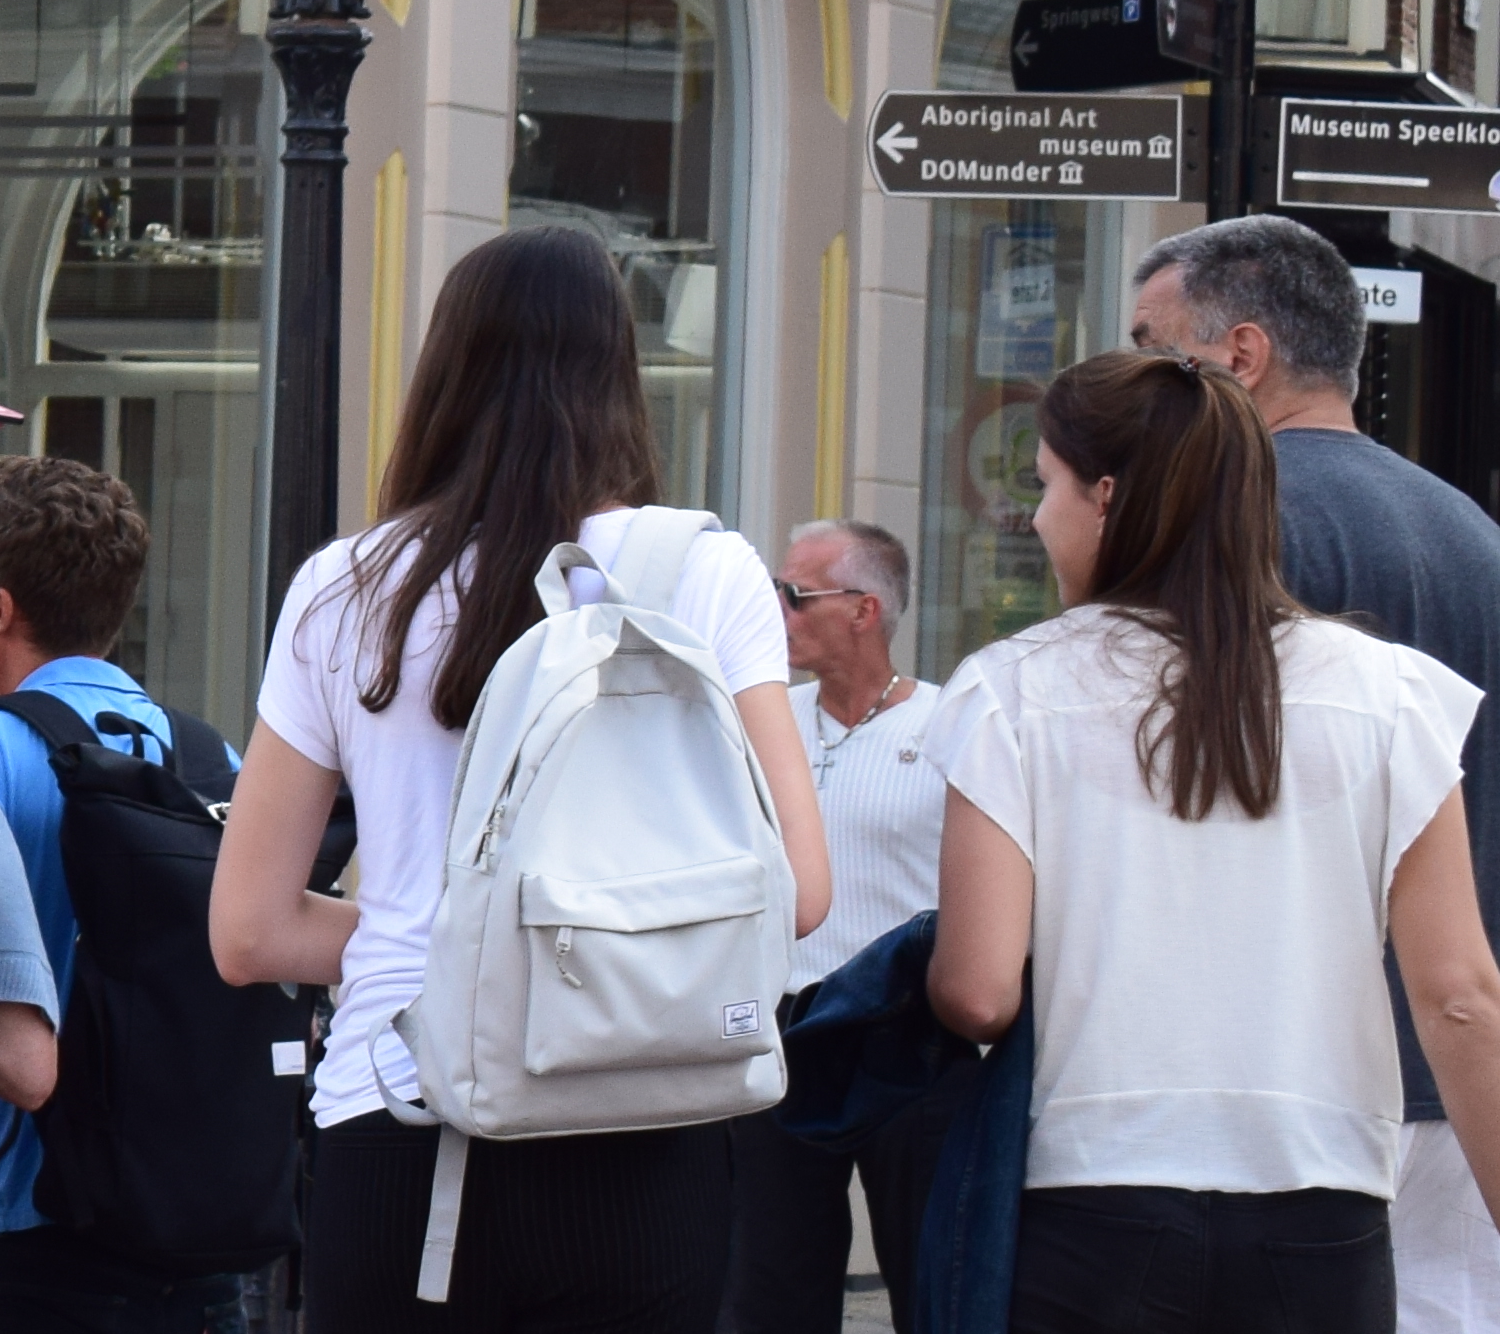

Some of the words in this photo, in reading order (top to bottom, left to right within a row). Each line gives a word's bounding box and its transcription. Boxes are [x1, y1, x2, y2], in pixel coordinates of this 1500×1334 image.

[1041, 5, 1120, 32] Springweg
[921, 104, 1051, 131] Aboriginal
[1058, 107, 1098, 129] Art
[1290, 113, 1391, 139] Museum
[1398, 119, 1500, 146] Speelklo
[1039, 137, 1142, 157] museum
[921, 158, 1052, 181] DOMunder
